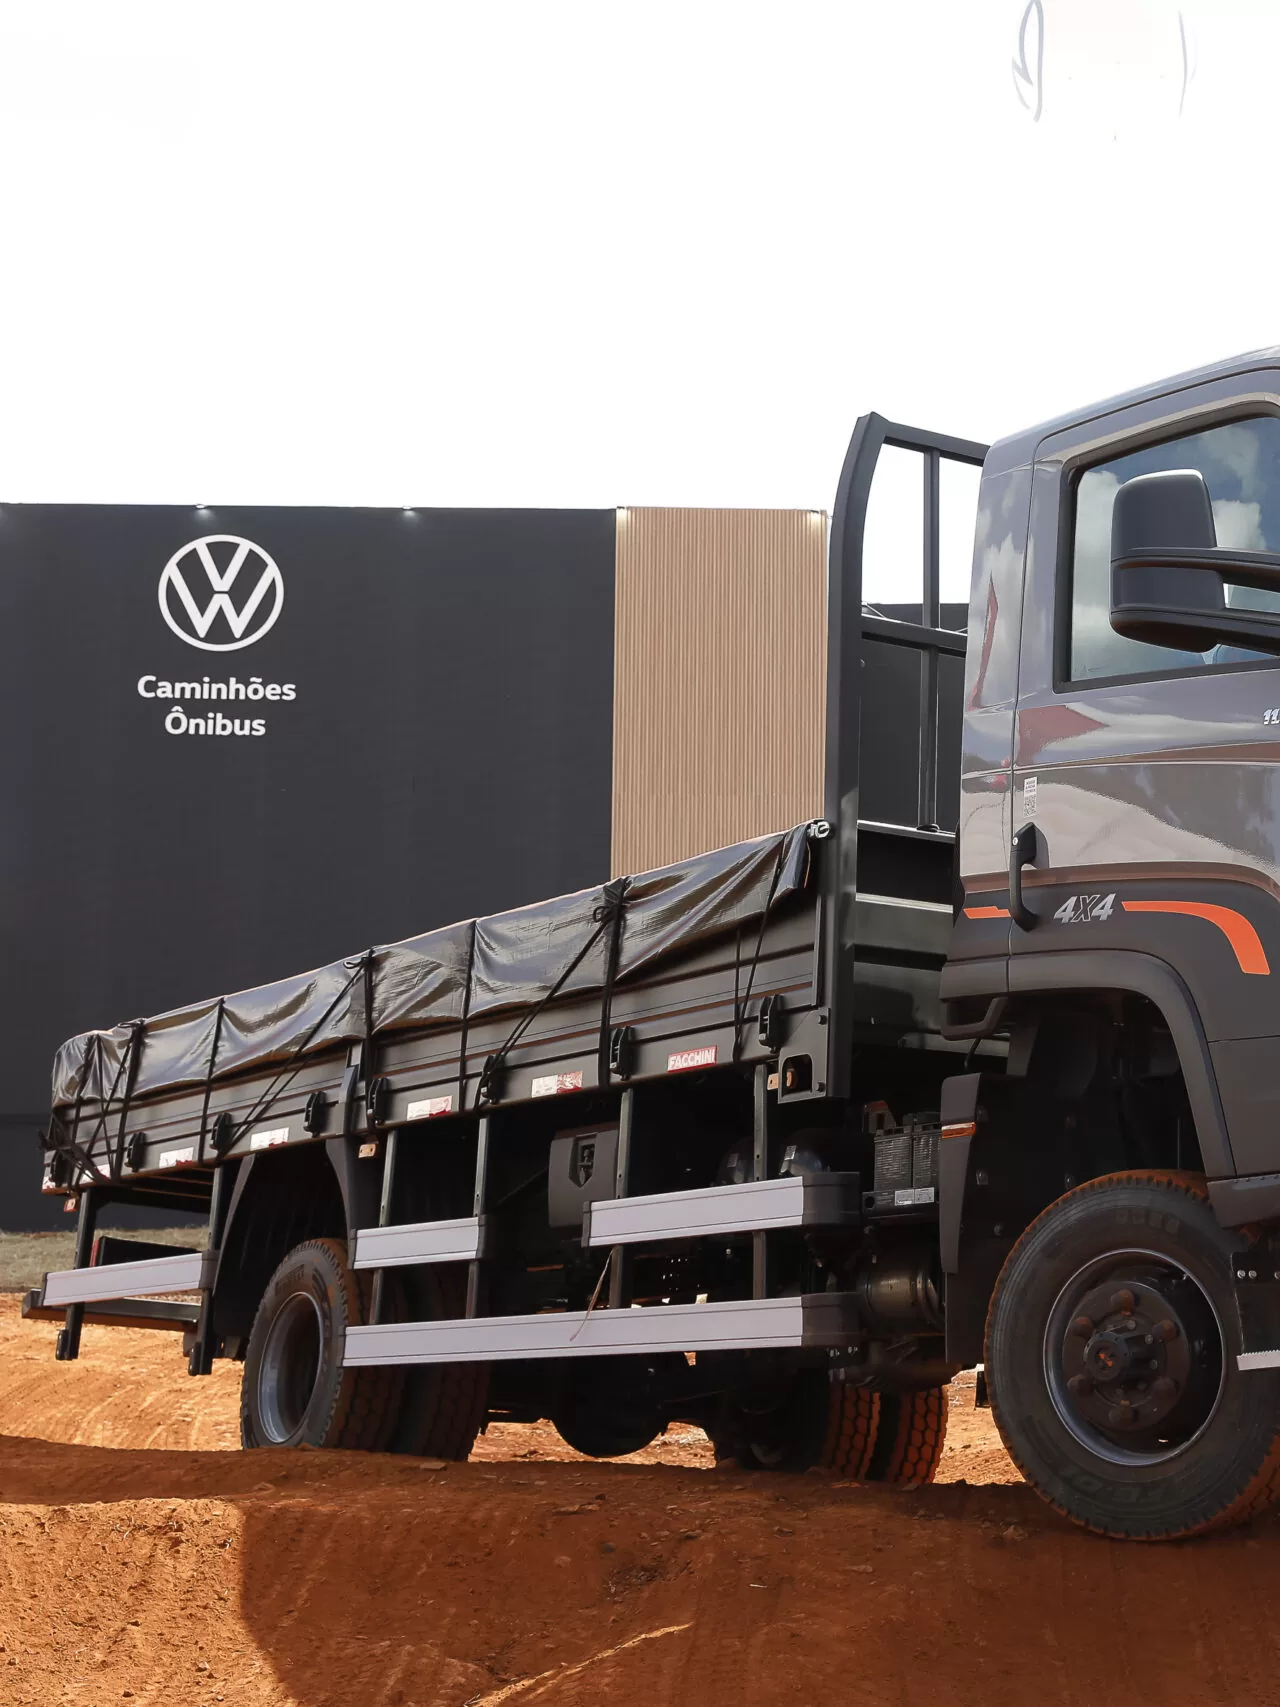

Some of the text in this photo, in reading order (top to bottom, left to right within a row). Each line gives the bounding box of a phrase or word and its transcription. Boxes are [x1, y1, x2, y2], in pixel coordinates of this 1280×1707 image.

[137, 675, 297, 701] Caminhões
[164, 705, 266, 736] Ônibus
[669, 1049, 716, 1070] FACCHINI
